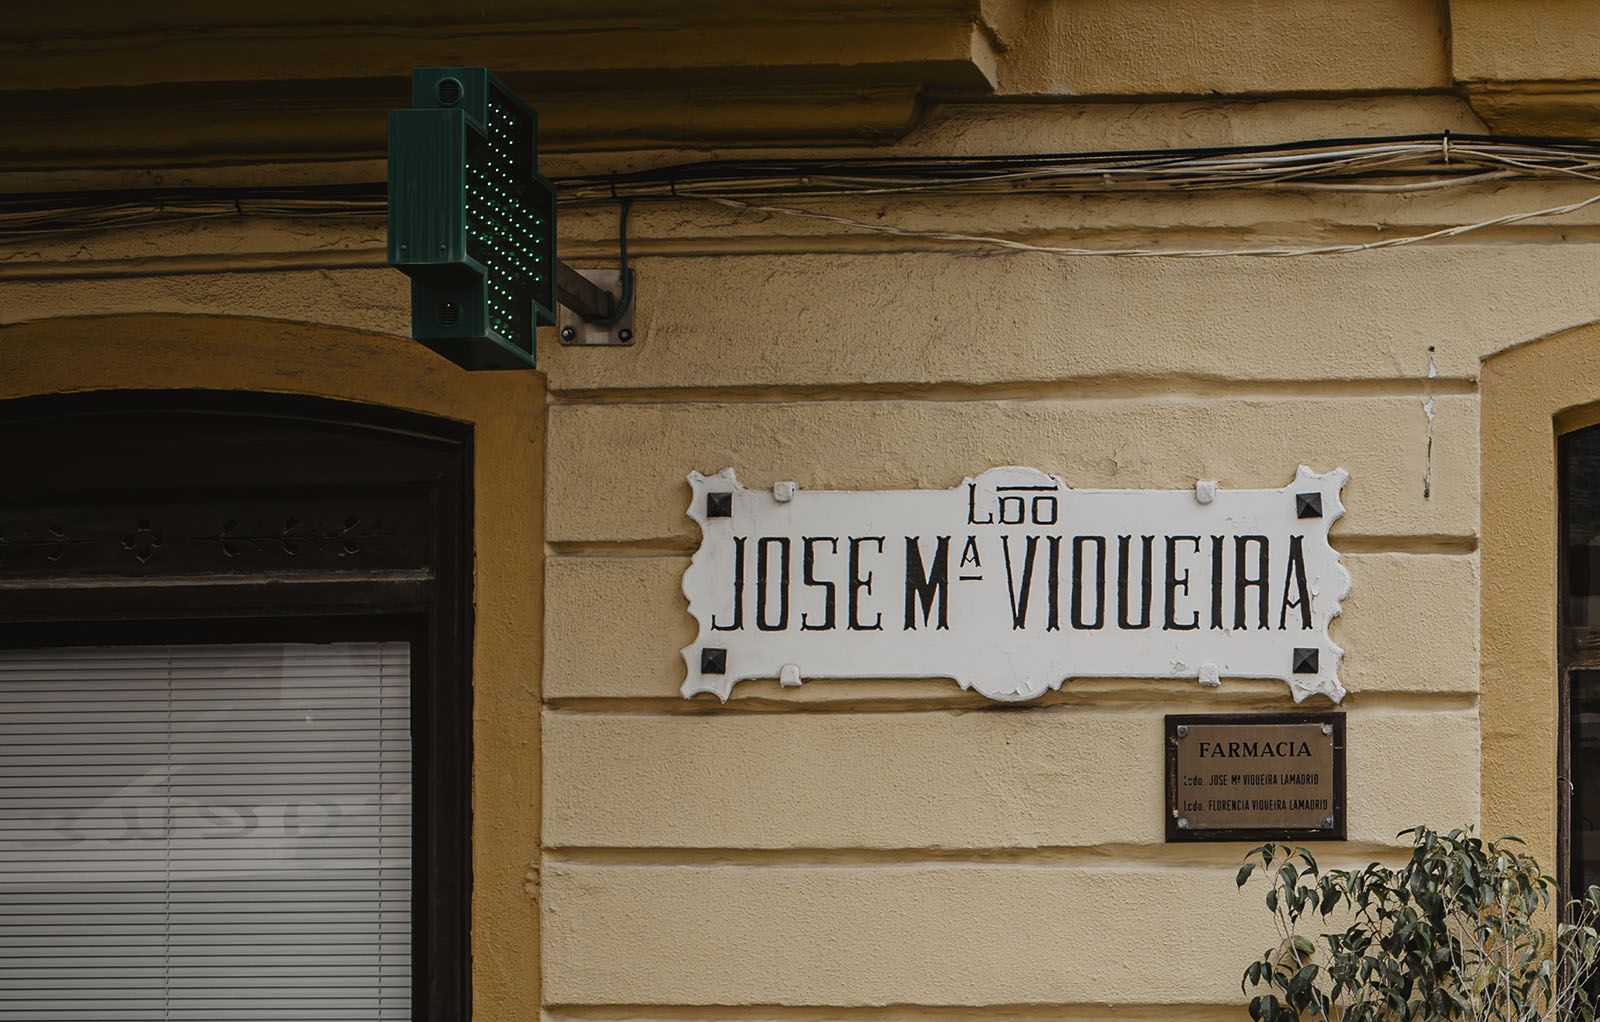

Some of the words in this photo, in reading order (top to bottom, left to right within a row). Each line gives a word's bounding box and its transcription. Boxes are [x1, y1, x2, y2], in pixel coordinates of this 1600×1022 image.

[710, 535, 886, 632] JOSE
[1199, 741, 1312, 758] FARMACIA
[1208, 774, 1228, 786] JOSE
[1243, 773, 1278, 786] VIQUEIRA
[1280, 773, 1319, 785] LAMADRID
[1208, 800, 1250, 812] FLORENCIA
[1289, 799, 1328, 811] LAMADRID
